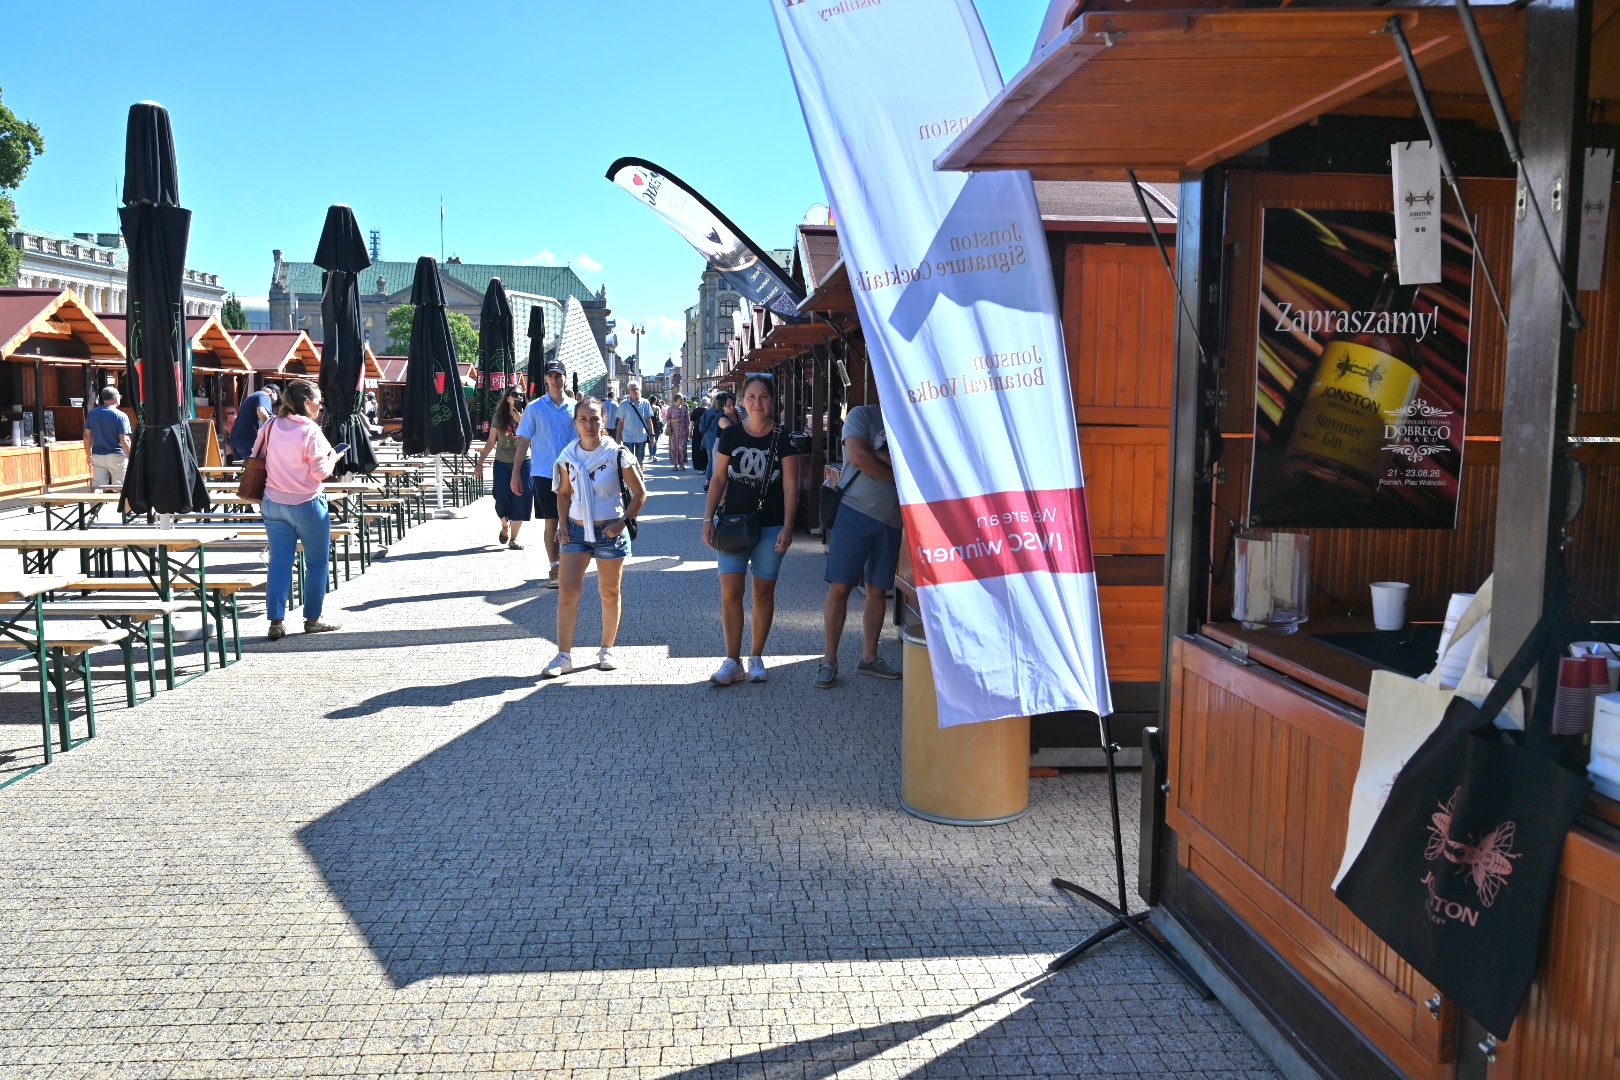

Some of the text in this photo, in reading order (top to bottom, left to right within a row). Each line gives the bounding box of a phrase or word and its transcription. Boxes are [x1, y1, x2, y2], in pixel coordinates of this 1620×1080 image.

[1275, 302, 1439, 342] Zapraszamy!
[1322, 386, 1380, 414] JONSTON
[1315, 412, 1365, 439] Summer
[1384, 425, 1450, 440] DOBREGO
[1323, 432, 1344, 449] Gin
[1405, 469, 1440, 477] 23.08.26
